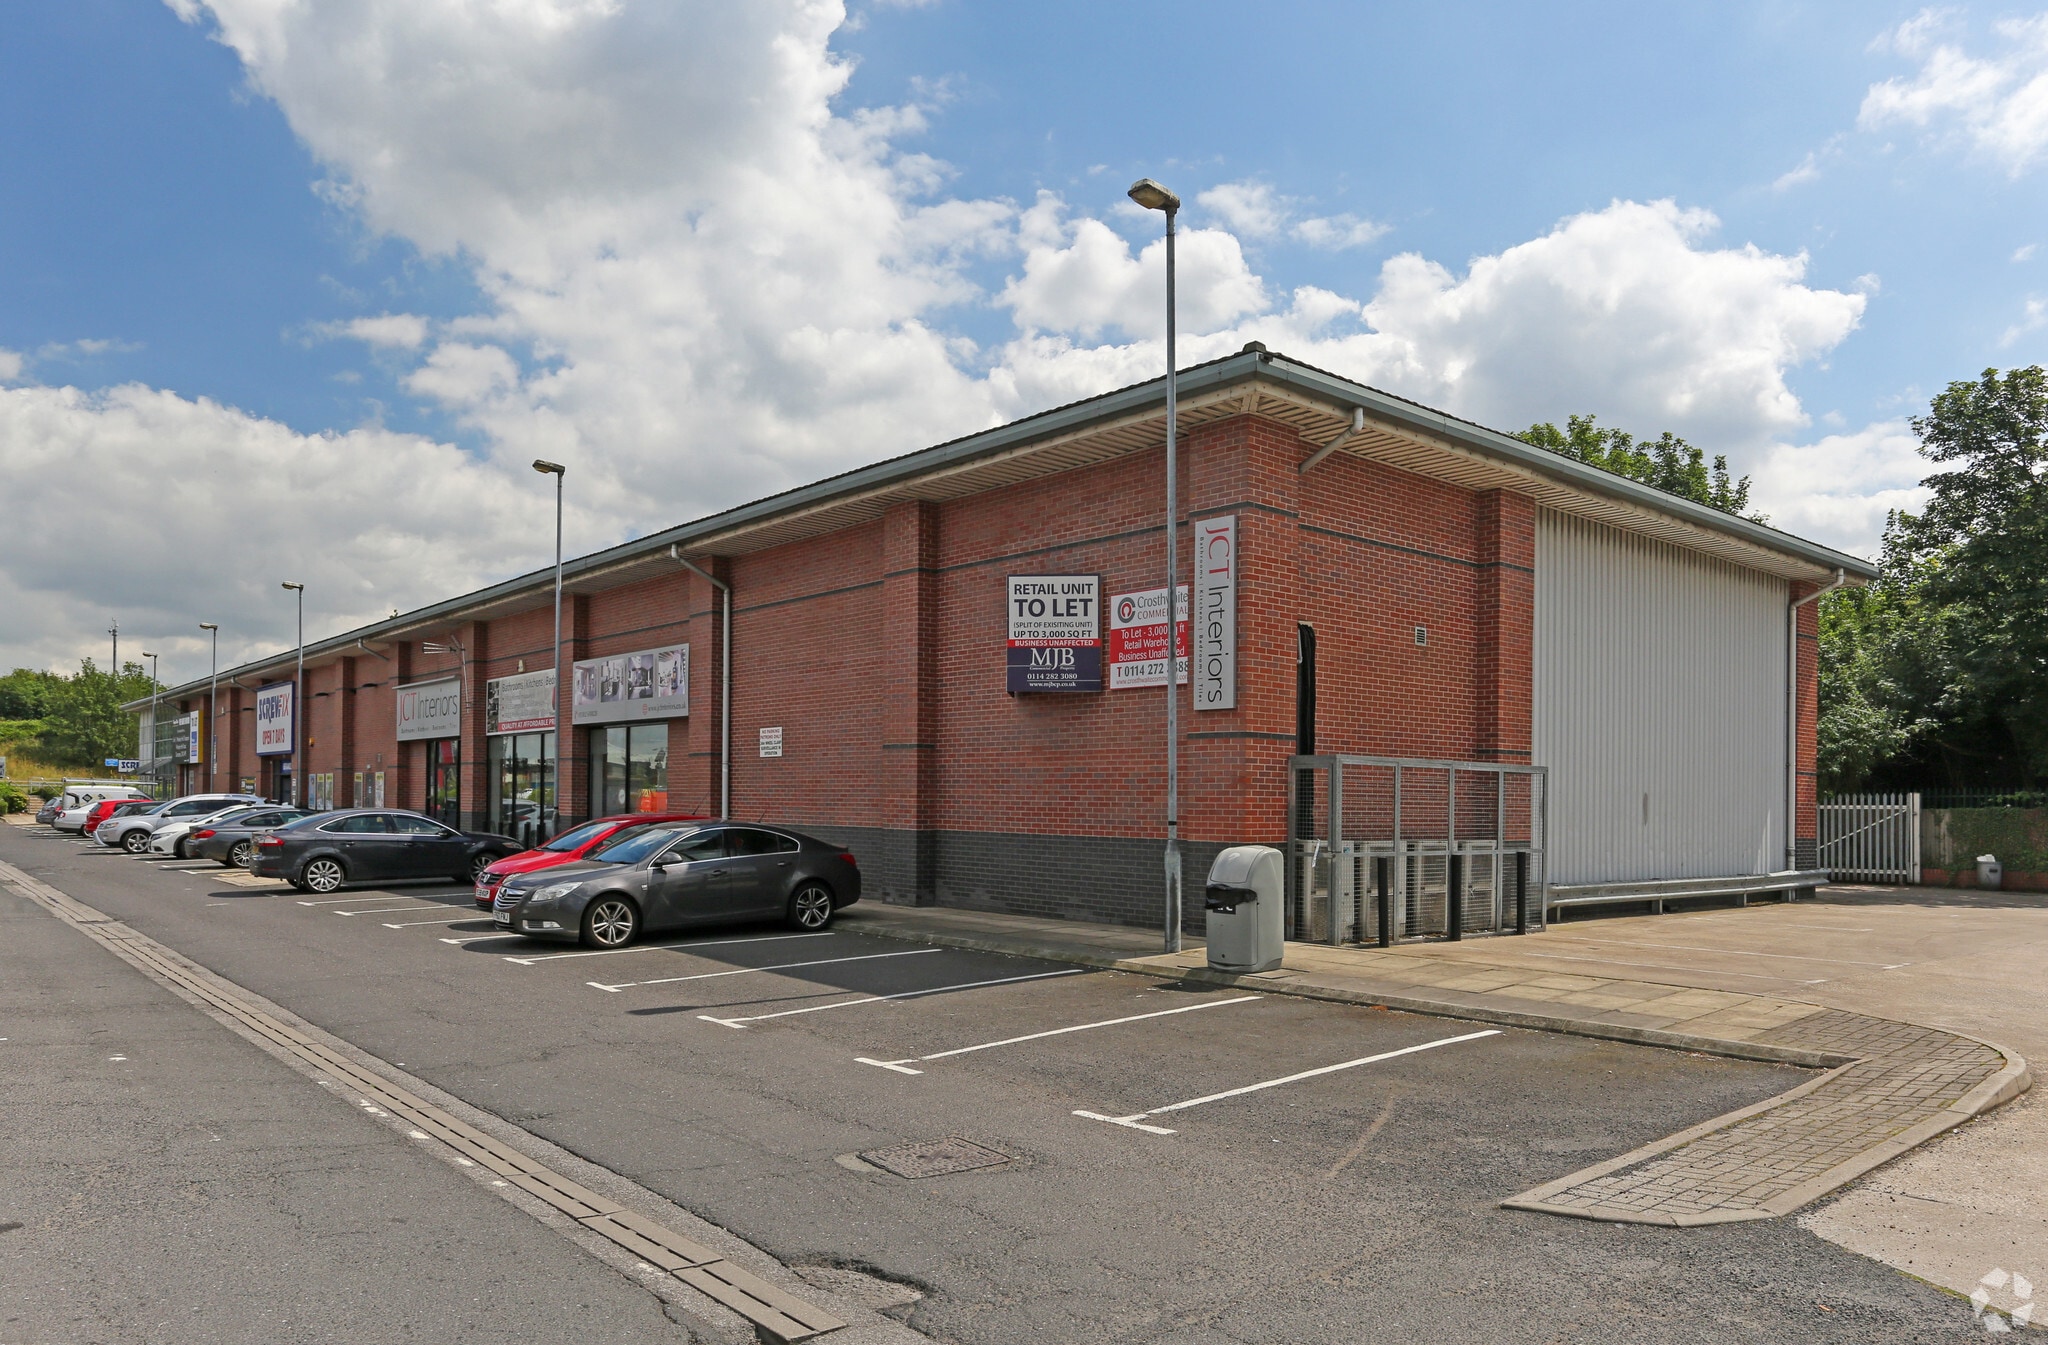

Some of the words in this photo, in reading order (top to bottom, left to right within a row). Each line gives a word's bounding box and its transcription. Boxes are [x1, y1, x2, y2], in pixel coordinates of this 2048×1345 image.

[1205, 526, 1230, 579] JCT
[1014, 583, 1058, 595] RETAIL
[1061, 583, 1093, 595] UNIT
[1014, 598, 1045, 617] TO
[1052, 598, 1093, 617] LET
[1137, 591, 1189, 609] Crosthite
[1137, 605, 1189, 620] COMMEIAL
[1013, 621, 1032, 629] (SPLIT
[1075, 621, 1093, 629] UNIT)
[1121, 629, 1130, 639] To
[1130, 628, 1142, 638] Let
[1148, 626, 1168, 637] 3,000
[1179, 622, 1185, 633] ft
[1041, 631, 1066, 639] 3,000
[1067, 630, 1080, 638] SQ
[1081, 630, 1092, 638] FT
[1124, 640, 1142, 650] Retail
[1142, 636, 1181, 648] Warehoe
[1208, 585, 1229, 703] Interiors
[1030, 647, 1075, 670] MJB
[1118, 651, 1147, 662] Business
[1116, 666, 1122, 677] T
[1124, 664, 1145, 677] 0114
[1147, 662, 1164, 675] 272
[525, 679, 544, 689] Kitchens
[1029, 681, 1077, 689] www.mjbcp.co.uk
[258, 692, 290, 724] SCREWFIX
[398, 692, 417, 727] JCT
[417, 688, 458, 720] Interiors
[502, 721, 517, 731] QUALITY
[517, 720, 523, 729] AT
[523, 718, 549, 728] AFFORDABLE
[262, 729, 272, 745] OPEN
[275, 727, 285, 744] DAYS
